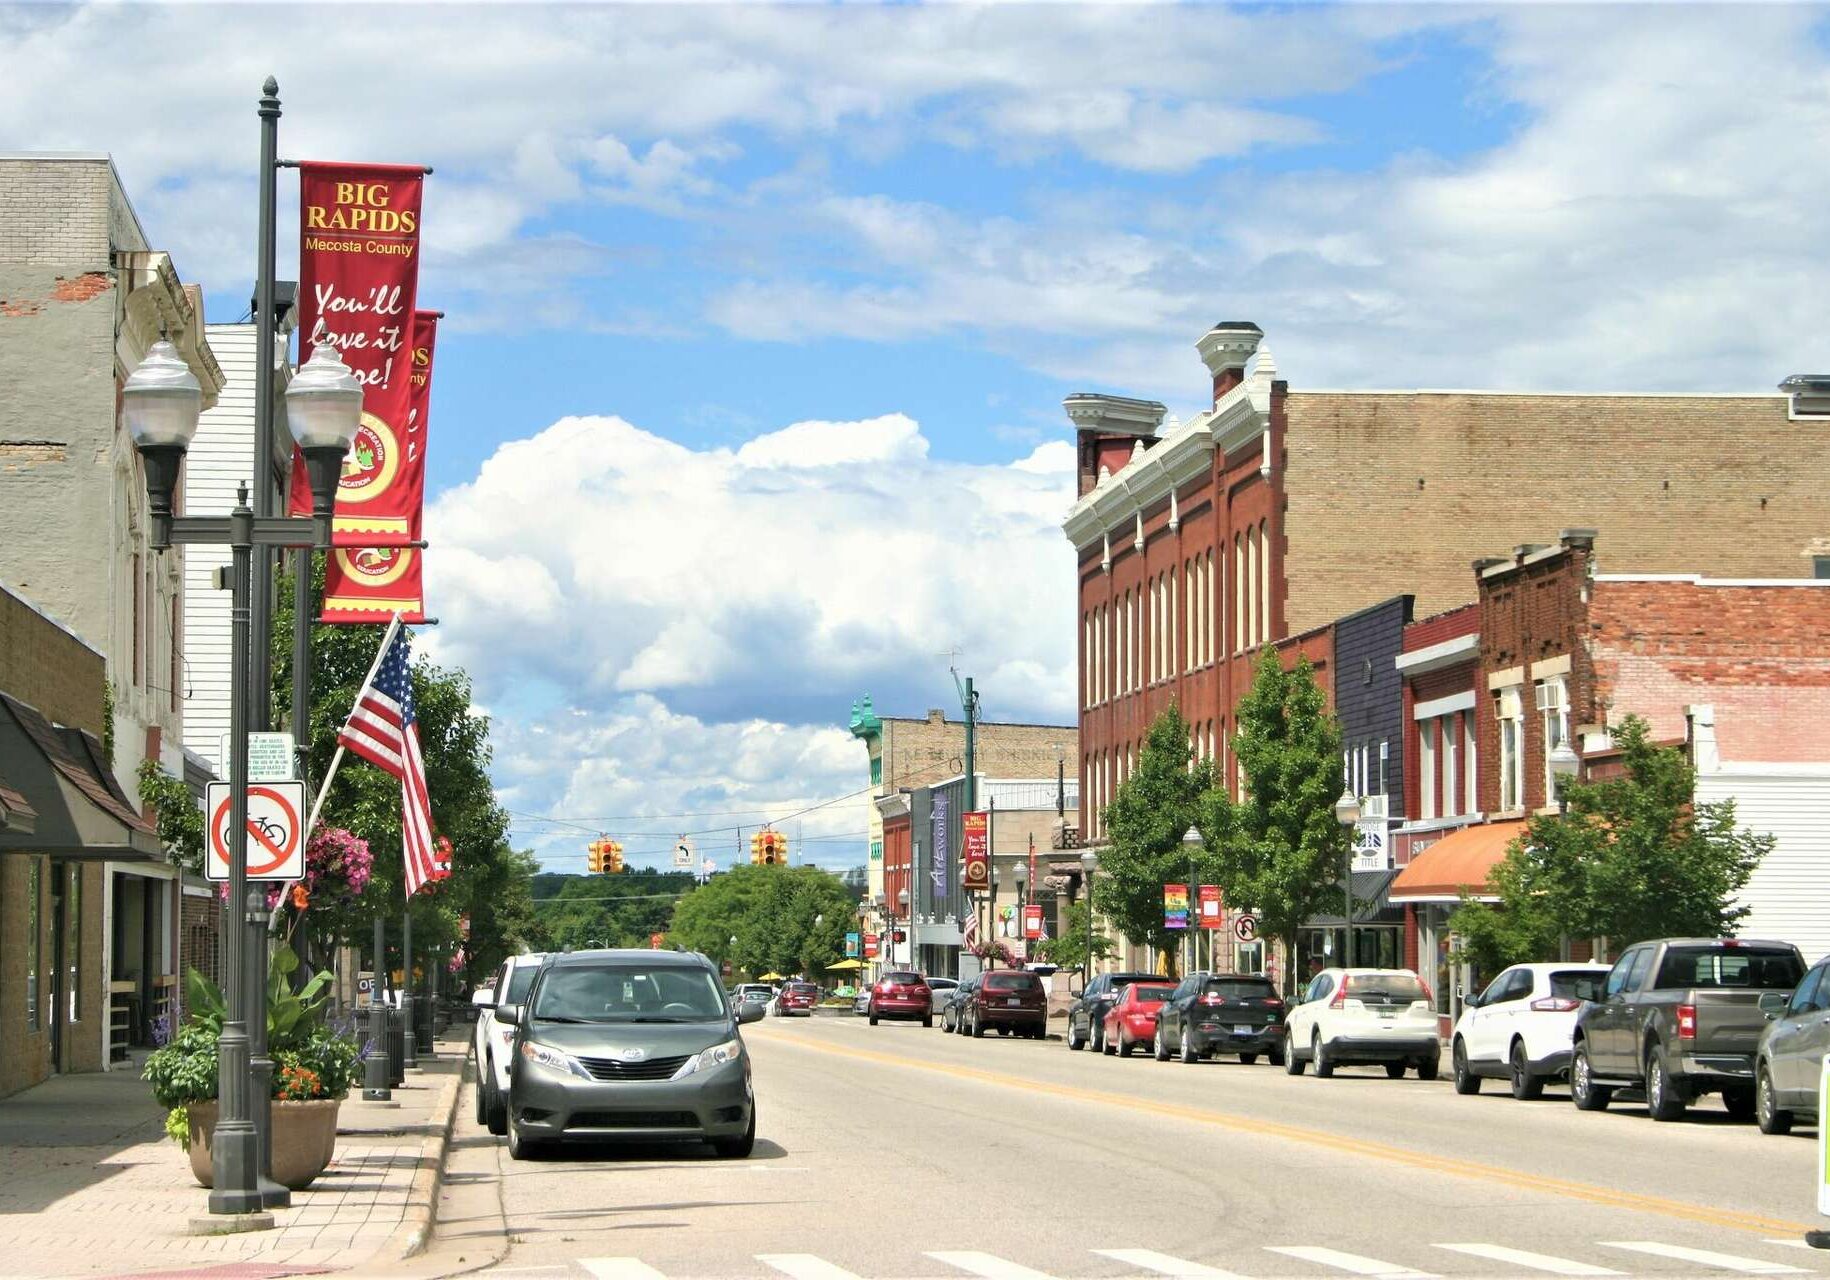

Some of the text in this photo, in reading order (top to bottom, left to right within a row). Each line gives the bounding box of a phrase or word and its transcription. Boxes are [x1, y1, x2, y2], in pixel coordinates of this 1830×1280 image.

[334, 182, 389, 207] BIG
[307, 206, 416, 233] RAPIDS
[305, 237, 413, 258] Mecosta County
[315, 283, 404, 315] You'll
[307, 317, 403, 352] love it
[353, 357, 393, 390] re!
[358, 426, 384, 461] ECREATION
[339, 476, 371, 488] UCATION
